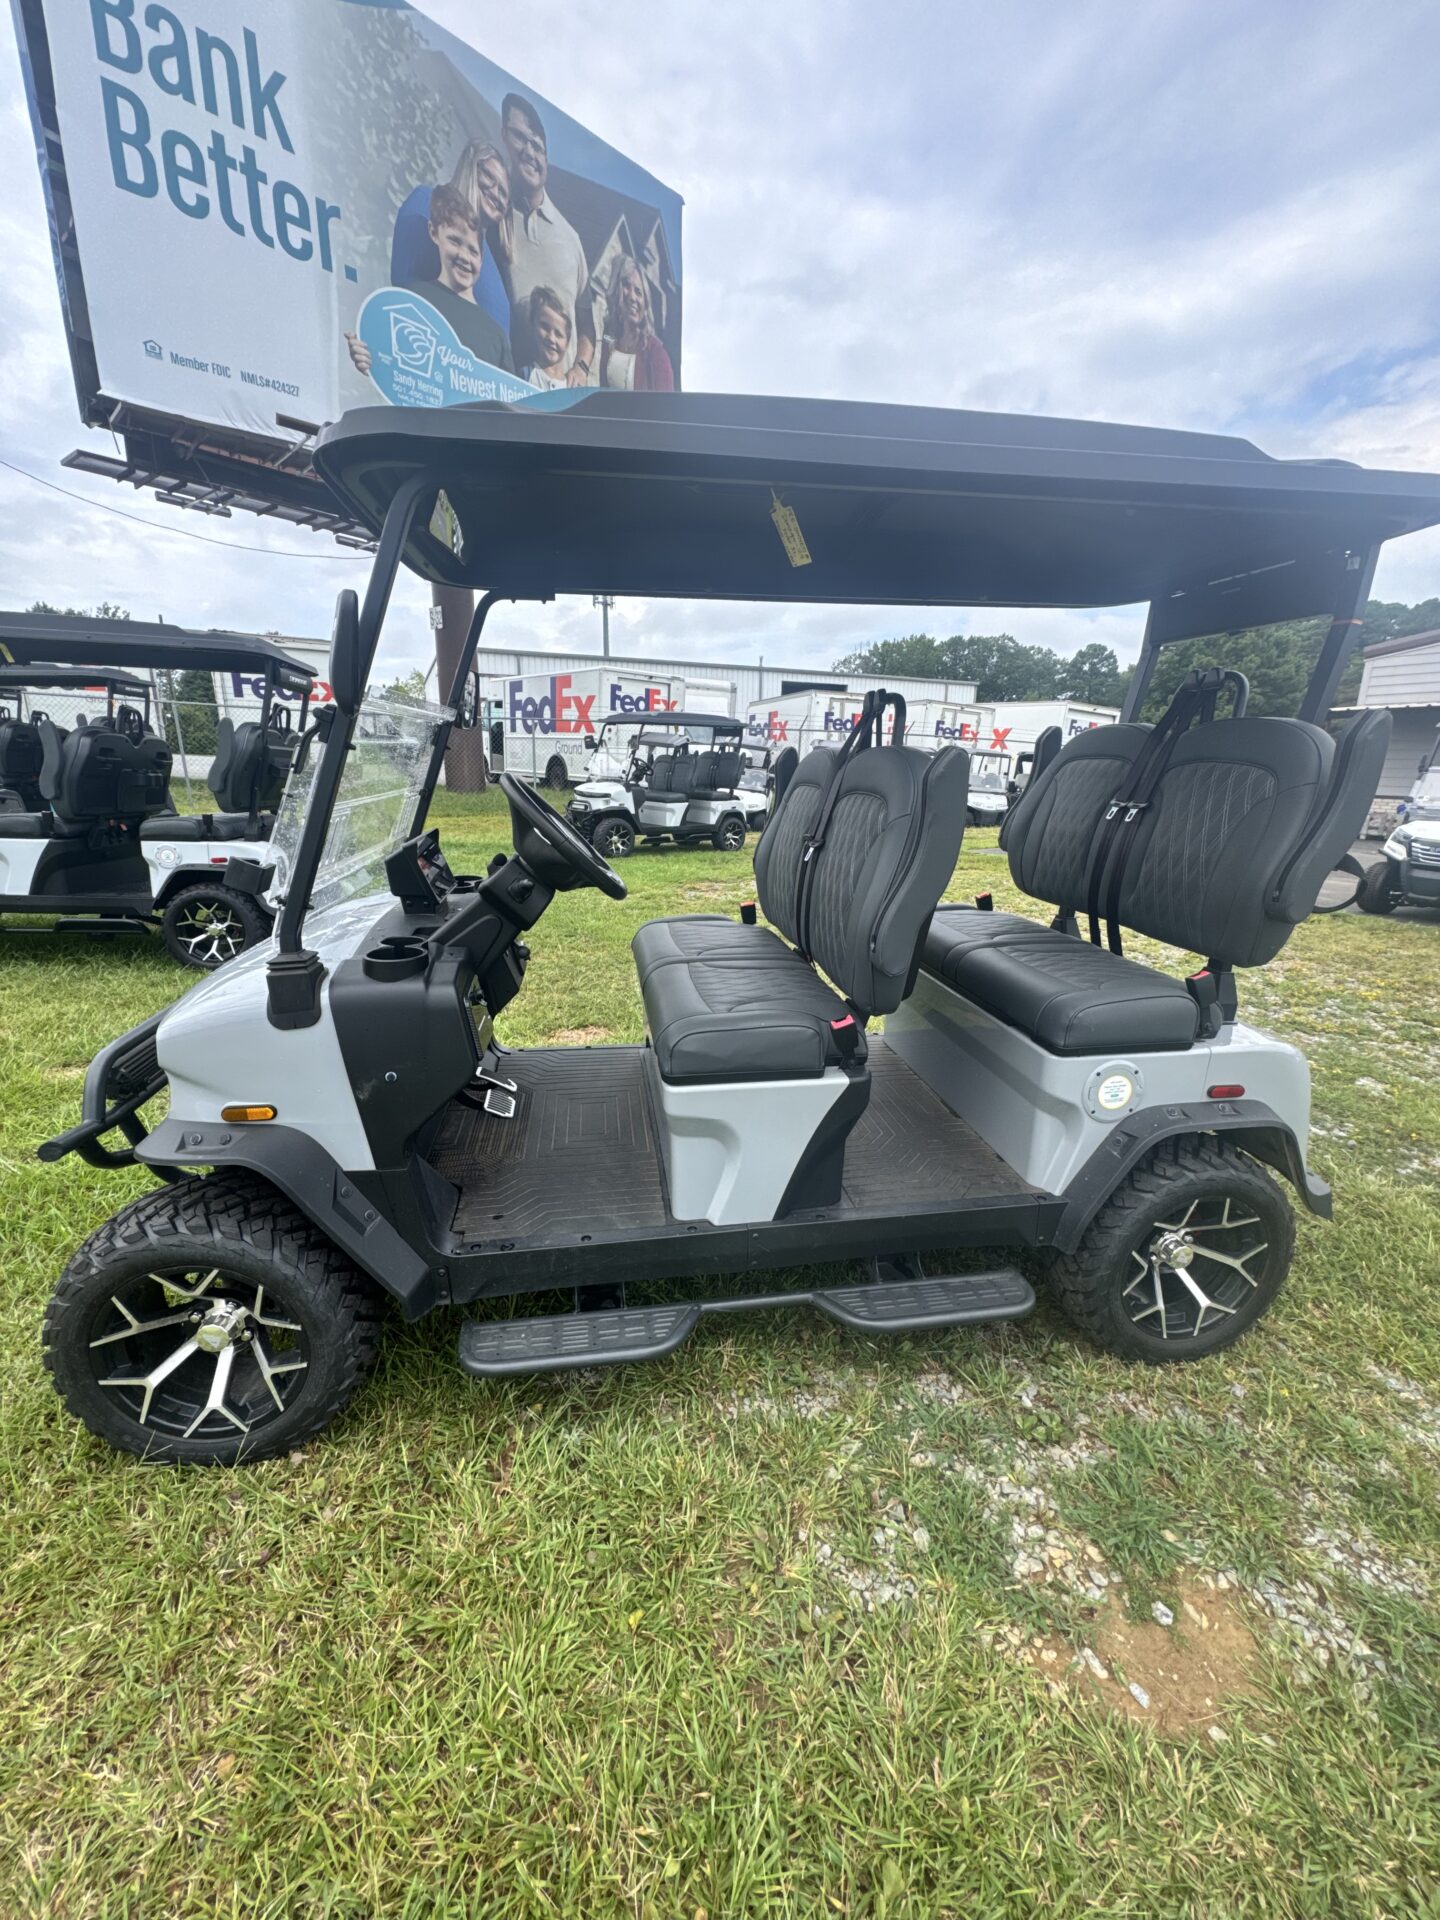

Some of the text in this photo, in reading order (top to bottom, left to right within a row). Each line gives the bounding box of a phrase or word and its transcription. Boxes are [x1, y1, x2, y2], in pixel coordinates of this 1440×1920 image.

[89, 0, 296, 156] Bank
[100, 75, 358, 283] Better.
[170, 351, 209, 373] Member
[212, 362, 232, 379] FDIC
[240, 370, 300, 397] NMLS#424327
[437, 345, 474, 372] Your
[393, 370, 416, 391] Sandy
[417, 379, 443, 401] Herring
[449, 367, 497, 401] Newest
[509, 675, 596, 735] FedEx
[610, 683, 678, 712] FedEx
[749, 711, 788, 741] FedEx
[935, 720, 980, 743] FedEx
[555, 741, 583, 755] Ground
